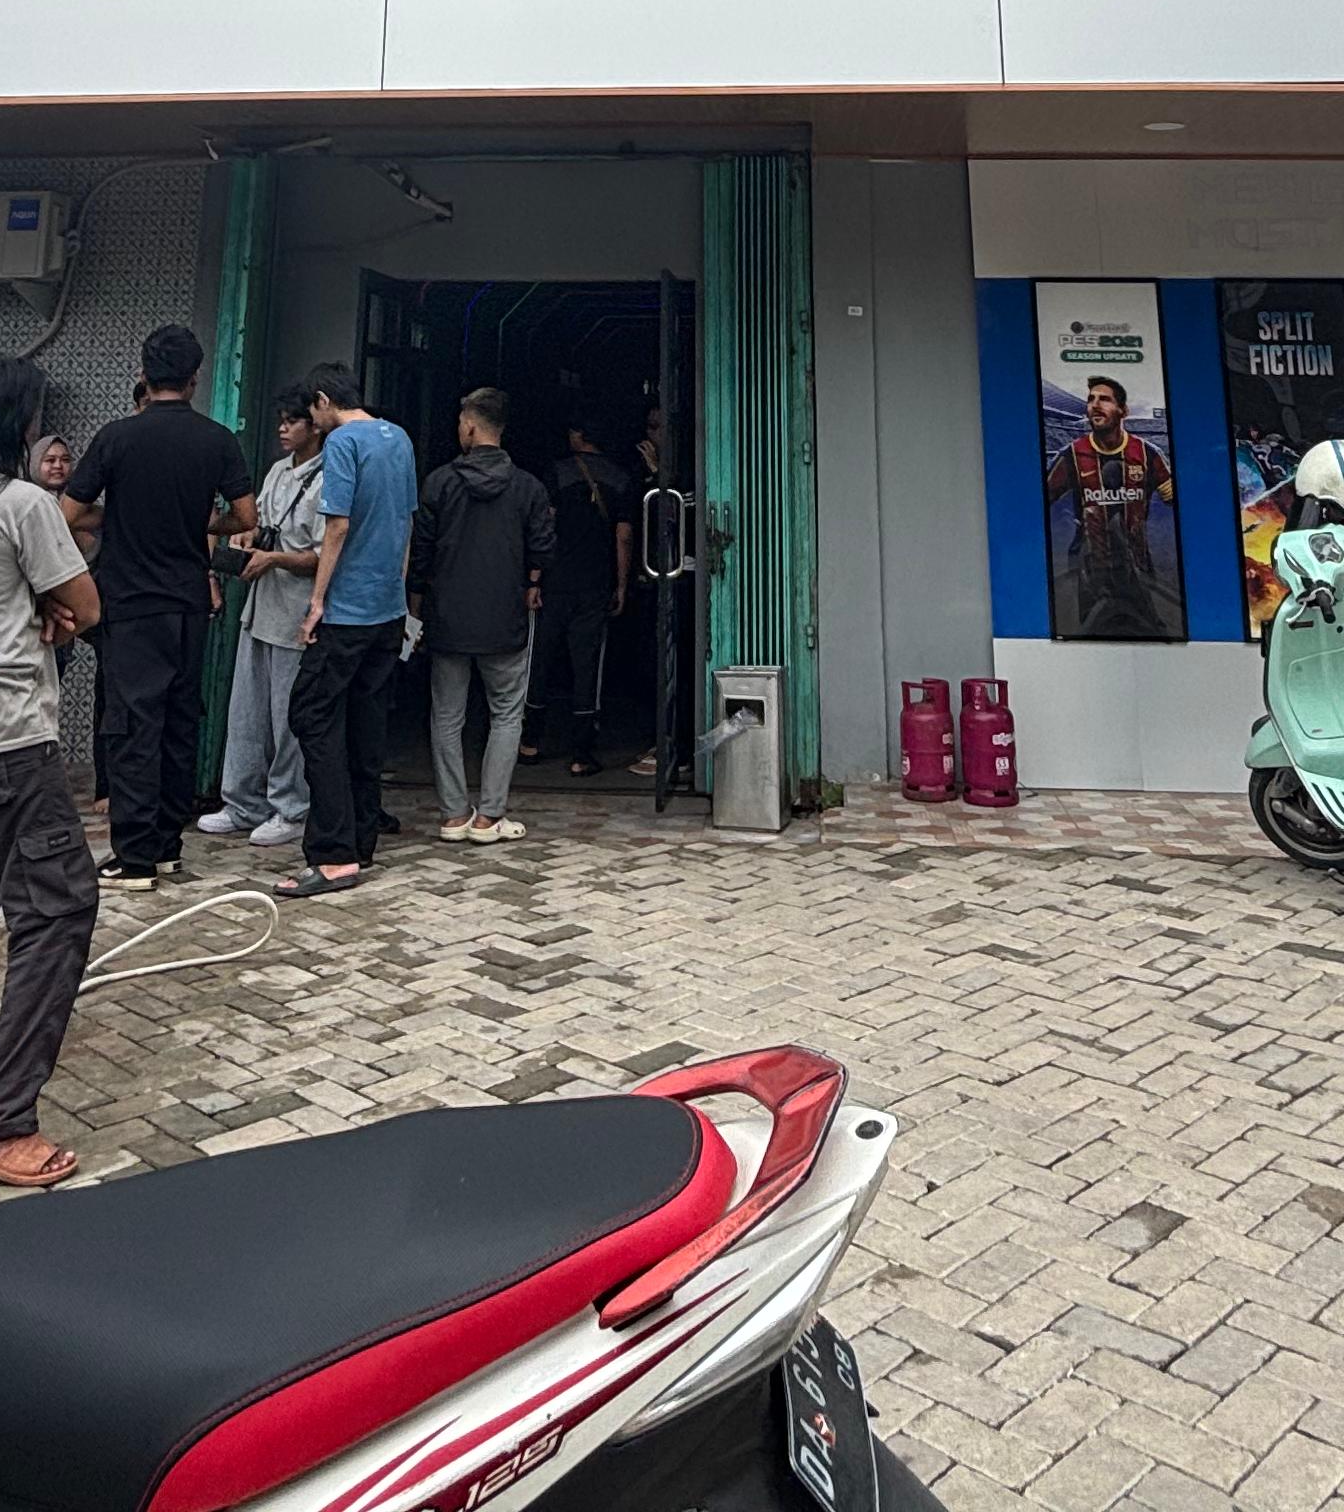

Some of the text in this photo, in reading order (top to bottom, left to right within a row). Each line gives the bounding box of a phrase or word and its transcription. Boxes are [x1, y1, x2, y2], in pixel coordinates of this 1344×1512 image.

[1257, 311, 1314, 341] SPLIT
[1248, 344, 1335, 376] FICTION
[1083, 488, 1144, 503] Rakuten
